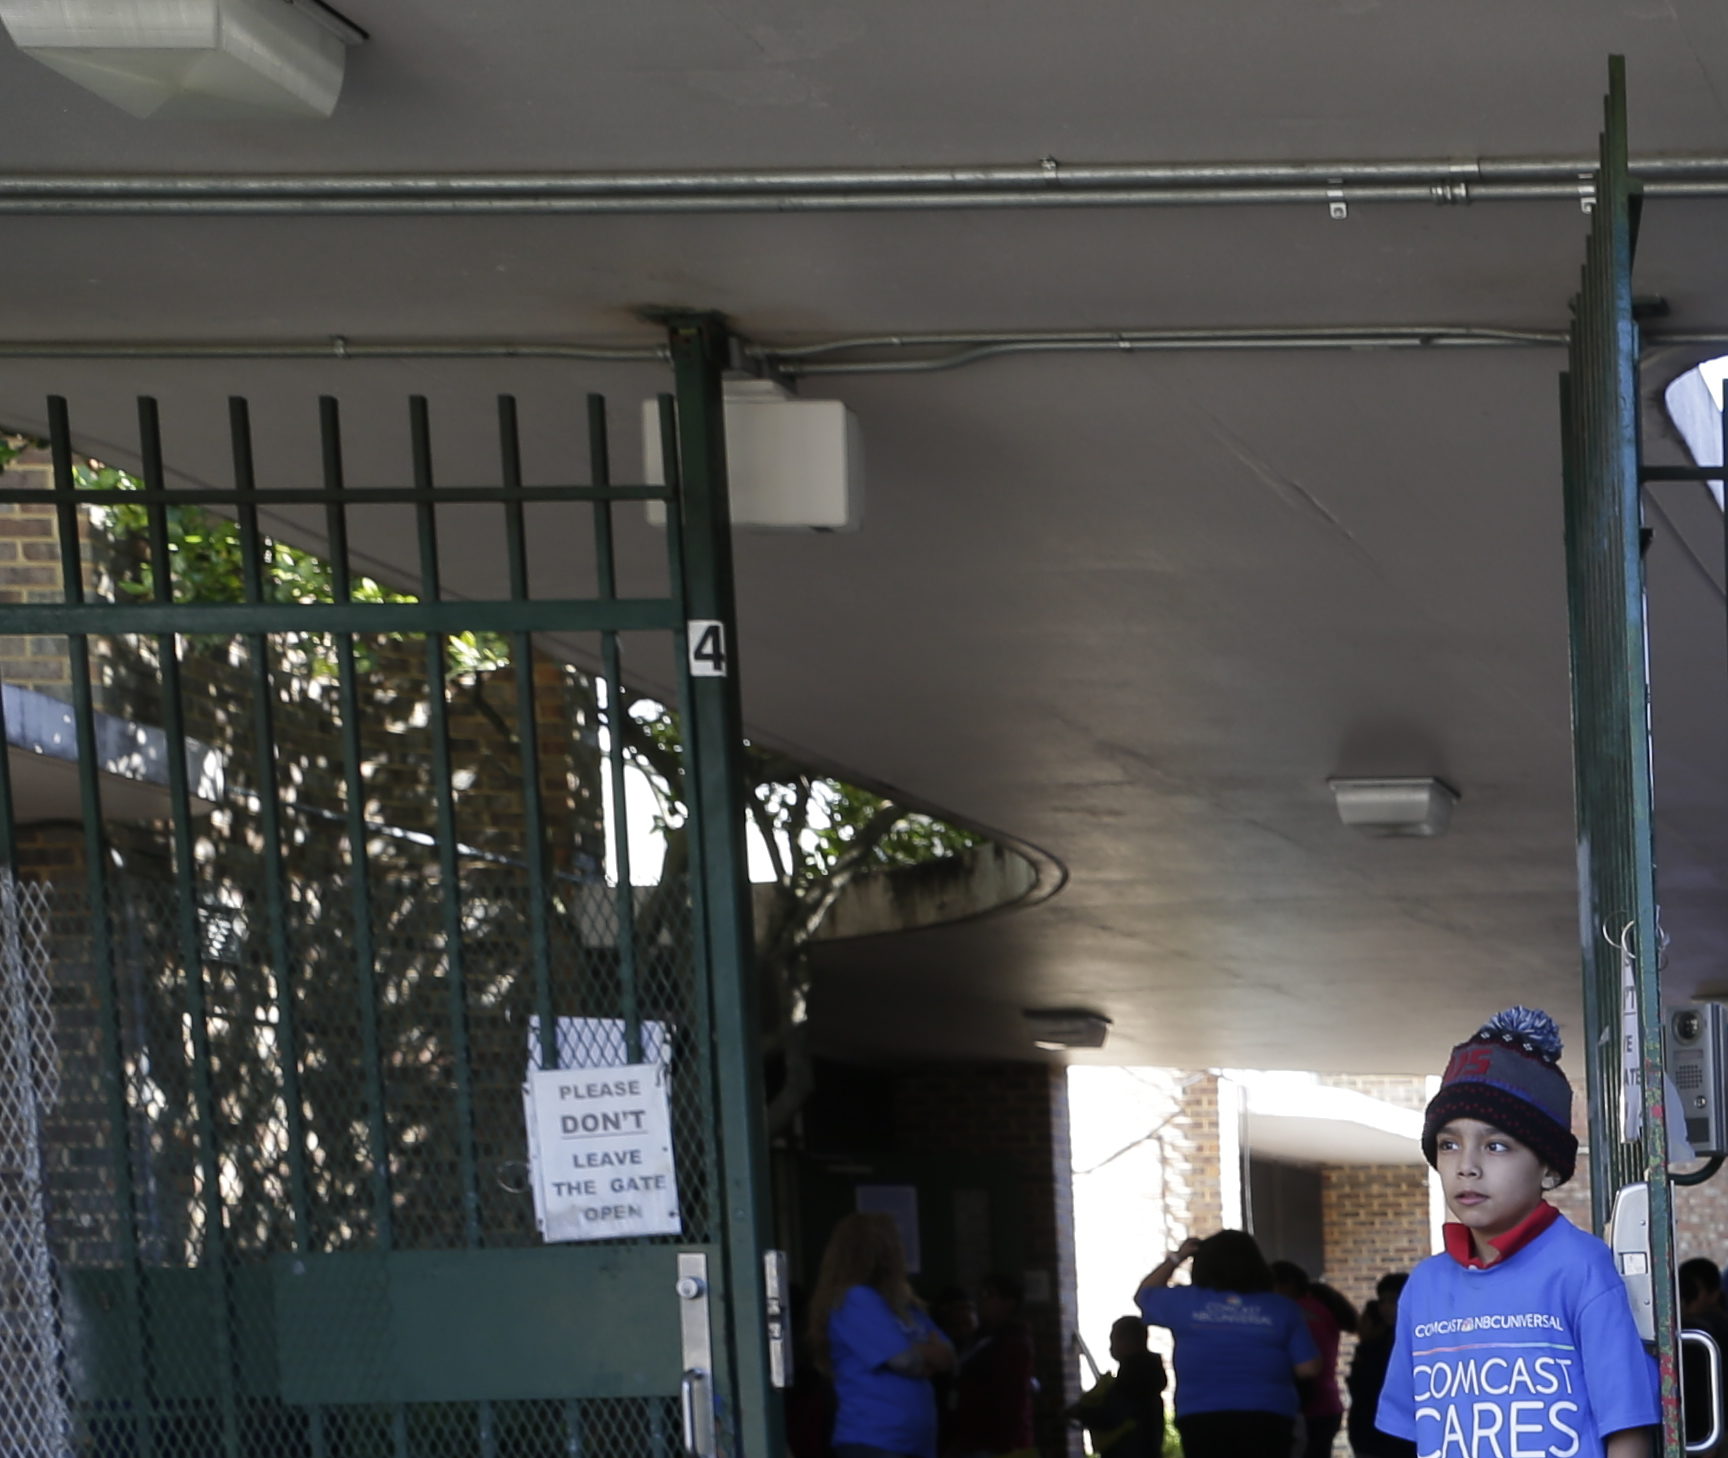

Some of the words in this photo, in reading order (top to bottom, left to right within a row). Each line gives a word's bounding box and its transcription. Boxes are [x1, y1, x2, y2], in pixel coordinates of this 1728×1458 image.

[693, 624, 725, 672] 4
[560, 1080, 641, 1100] PLEASE
[561, 1109, 645, 1133] DON'T
[573, 1149, 642, 1168] LEAVE
[551, 1178, 596, 1197] THE
[610, 1174, 666, 1193] GATE
[584, 1204, 642, 1222] OPEN
[1414, 1317, 1463, 1338] COMCAST
[1474, 1312, 1564, 1332] NBCUNIVERSAL
[1413, 1354, 1573, 1403] COMCAST
